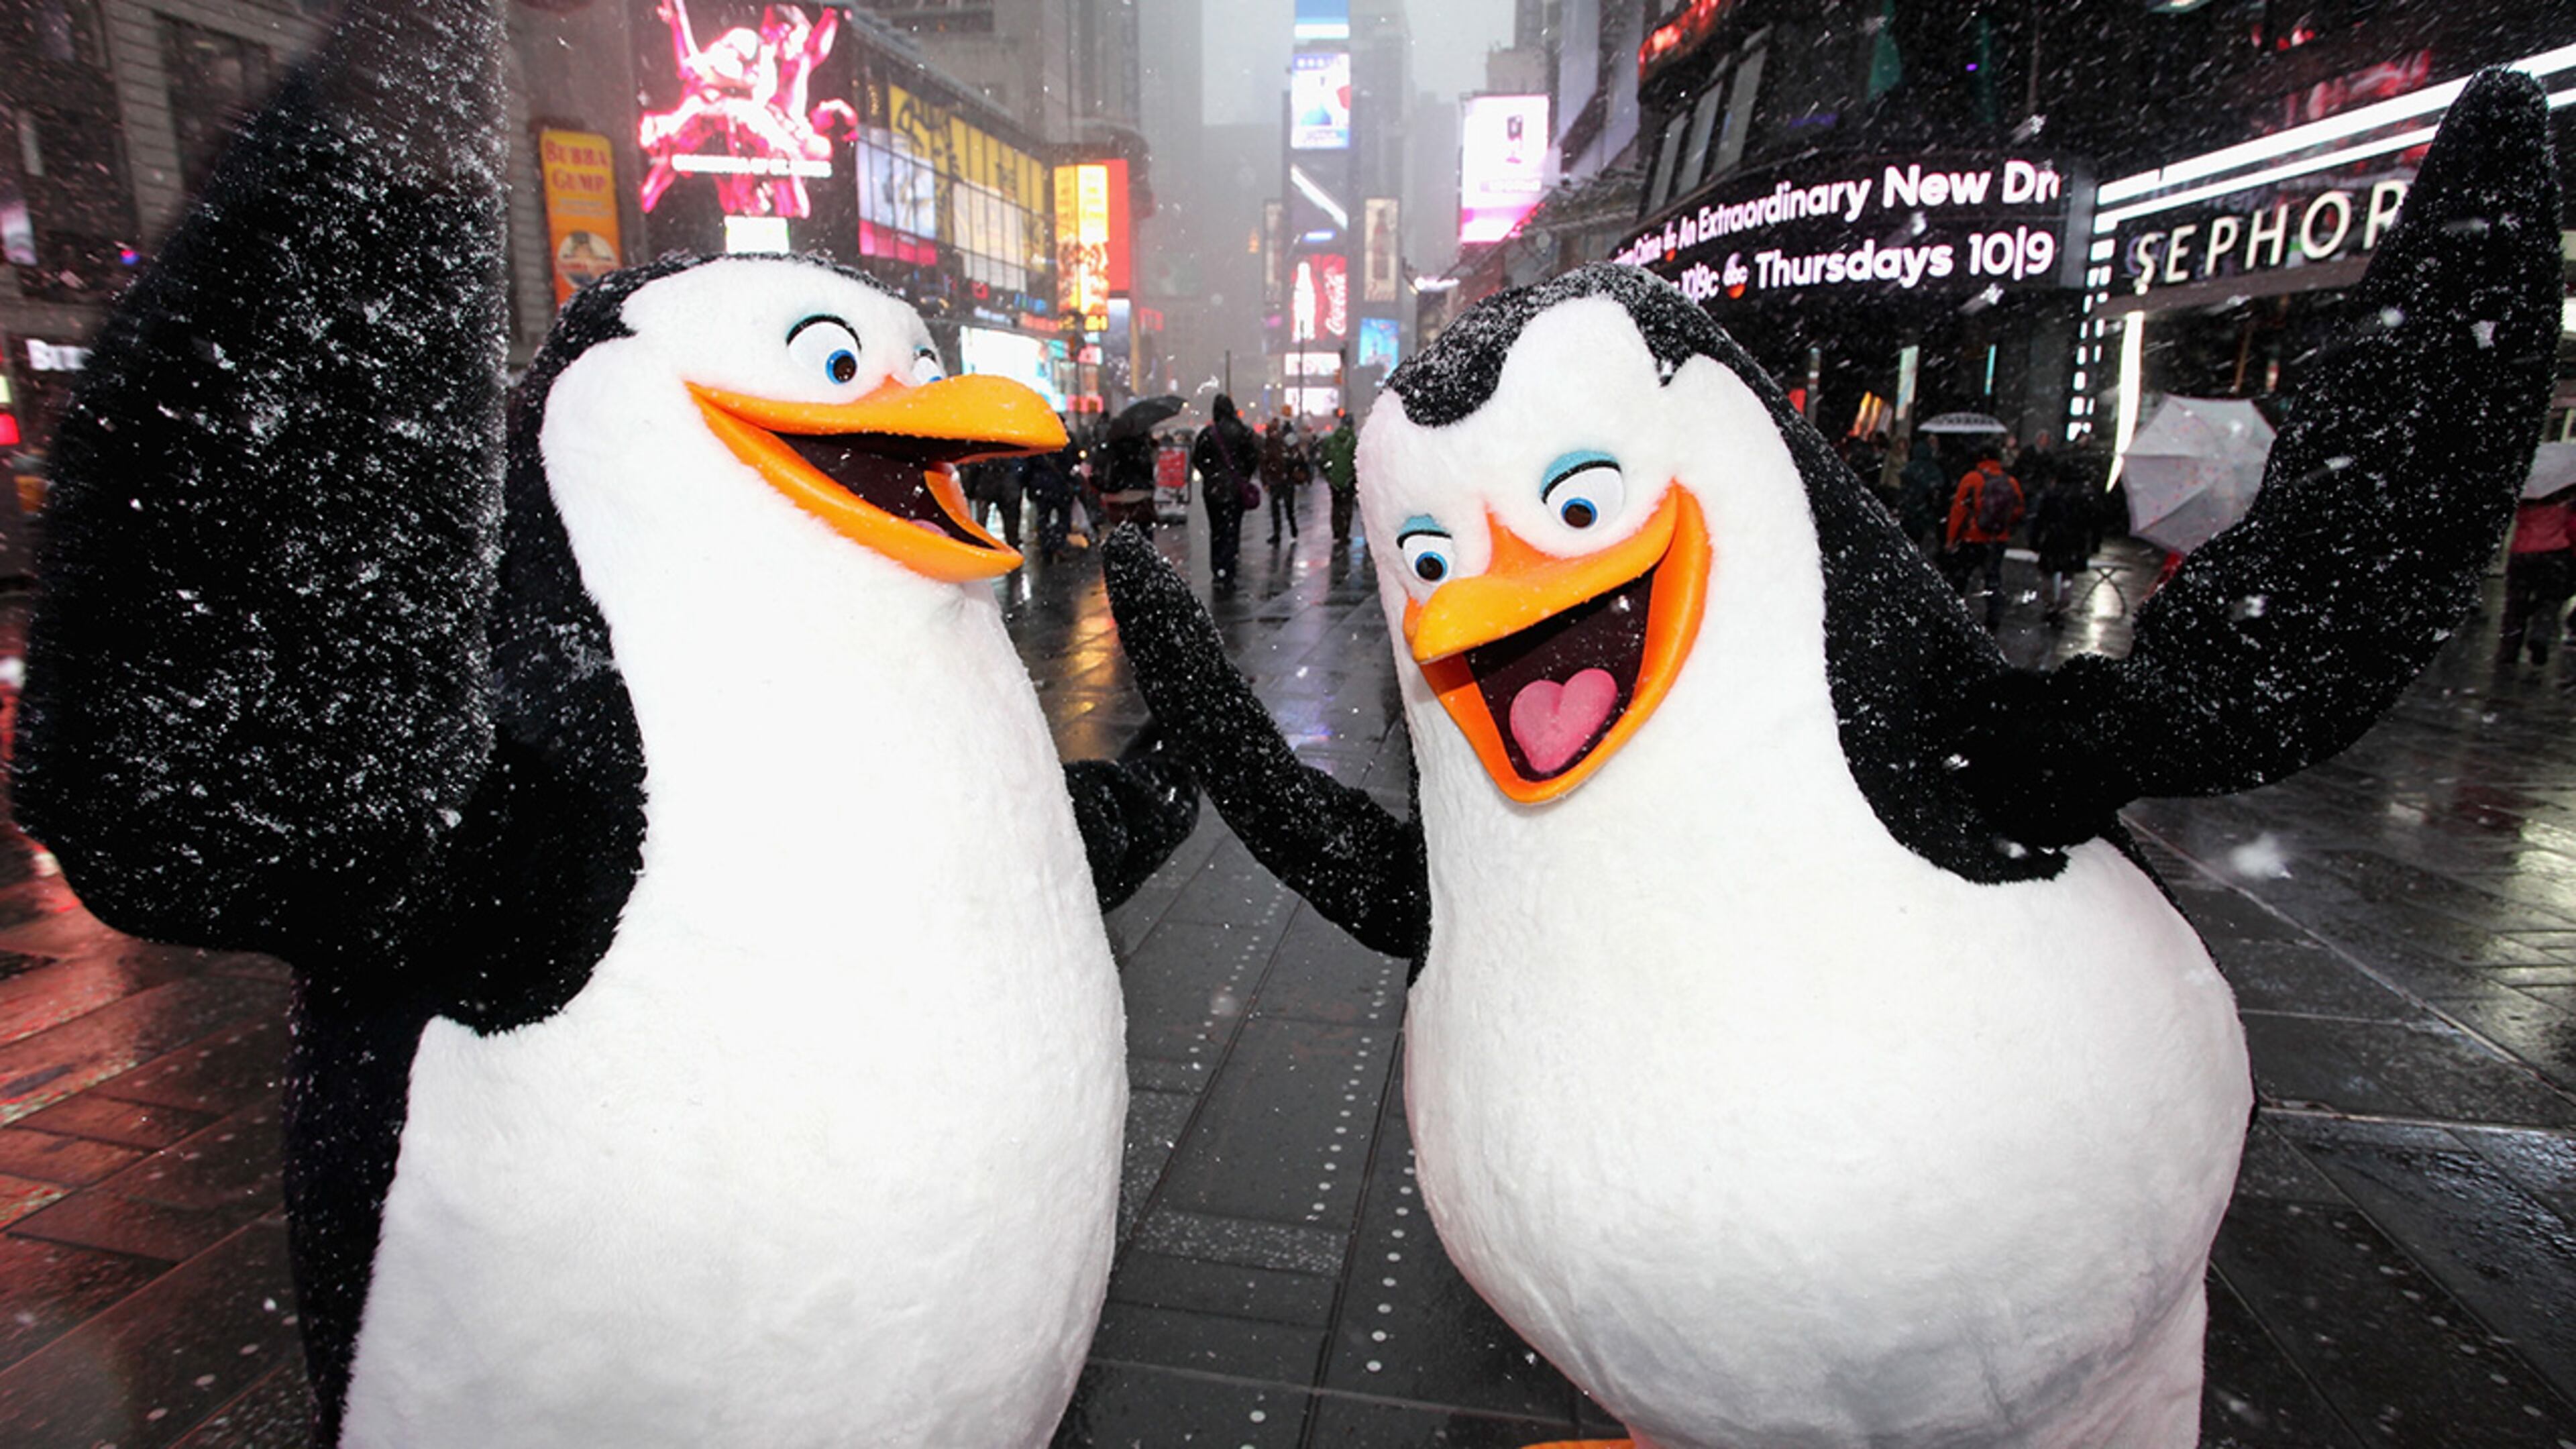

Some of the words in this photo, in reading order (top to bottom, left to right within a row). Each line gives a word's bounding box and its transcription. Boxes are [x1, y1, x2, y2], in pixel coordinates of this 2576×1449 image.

[1699, 178, 1873, 243] Extraordinary
[1882, 164, 1992, 209] New
[2136, 179, 2410, 284] SEPHOR
[1754, 238, 1954, 288] Thursdays
[1968, 225, 2055, 280] 10|9
